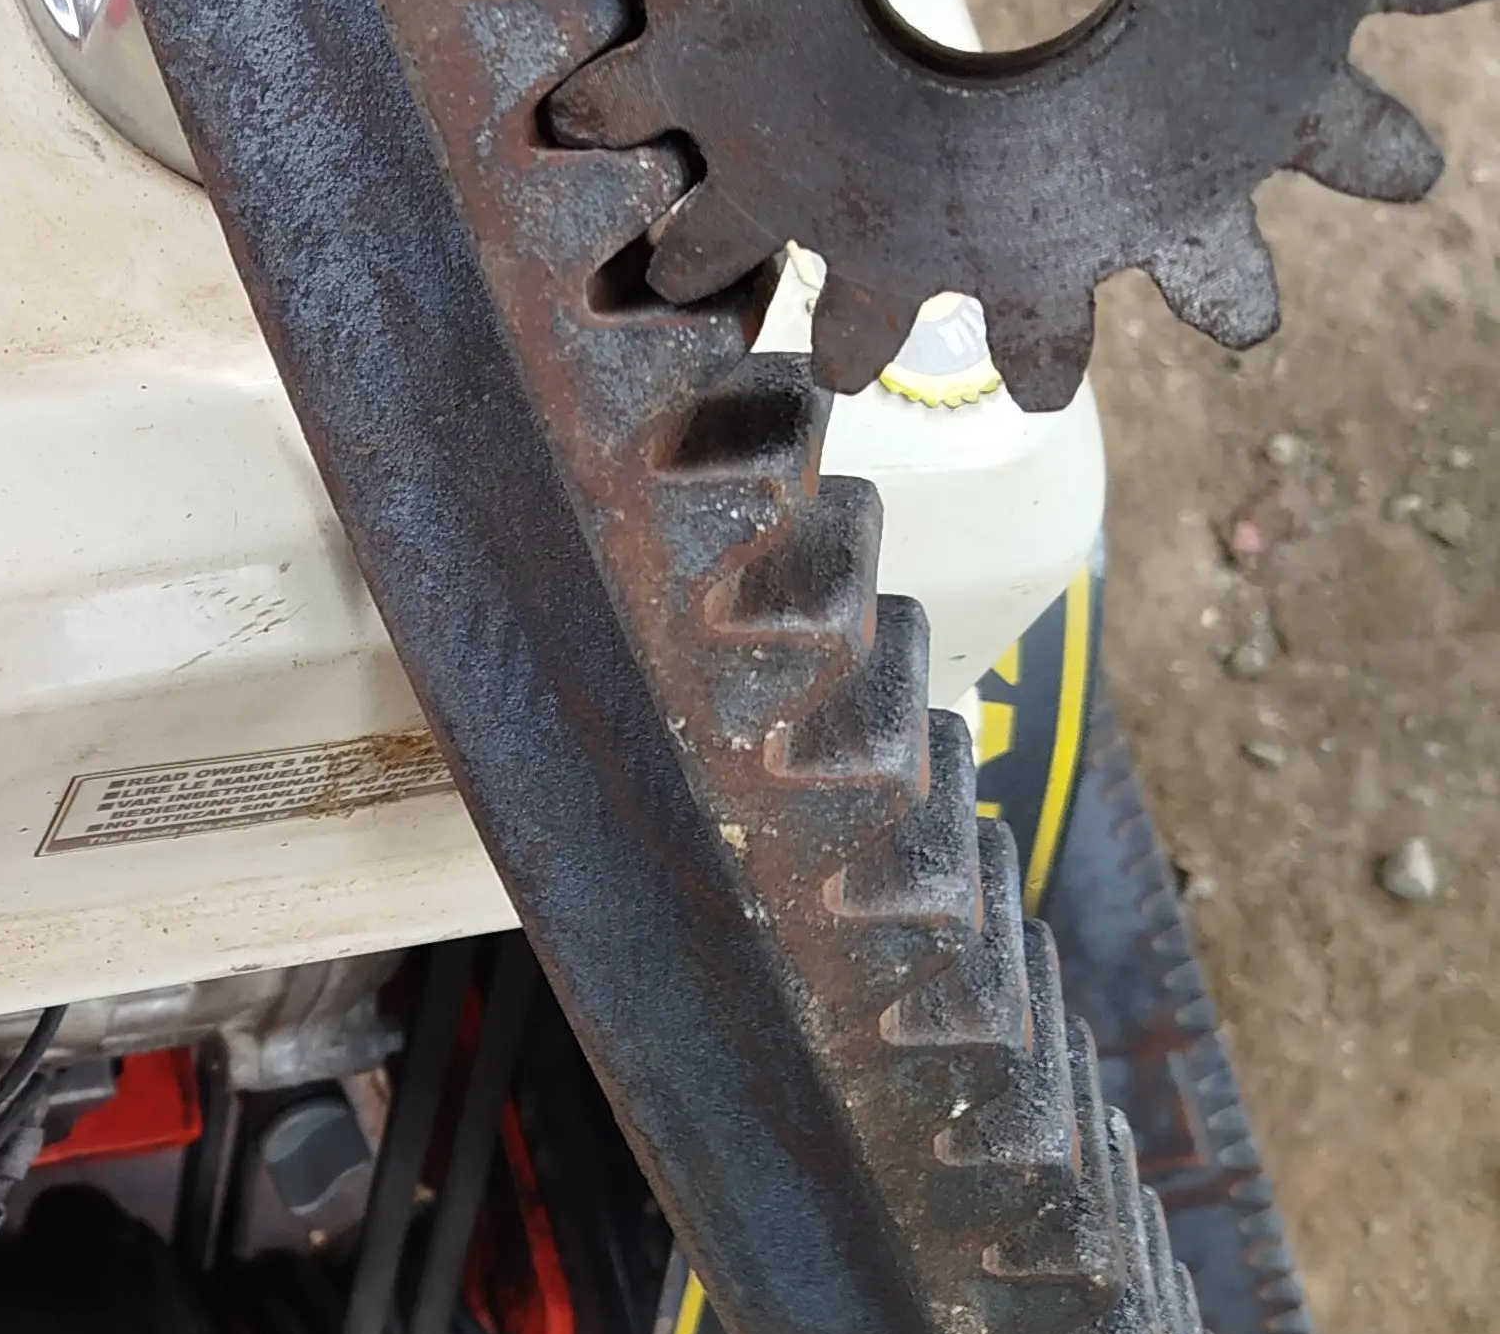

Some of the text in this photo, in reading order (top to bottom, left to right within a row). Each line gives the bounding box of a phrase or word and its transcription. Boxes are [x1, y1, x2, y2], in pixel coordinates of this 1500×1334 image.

[125, 773, 189, 786] READ
[302, 745, 382, 765] MANU
[120, 785, 172, 798] LIRE
[179, 780, 206, 791] LE
[104, 819, 138, 830] NO
